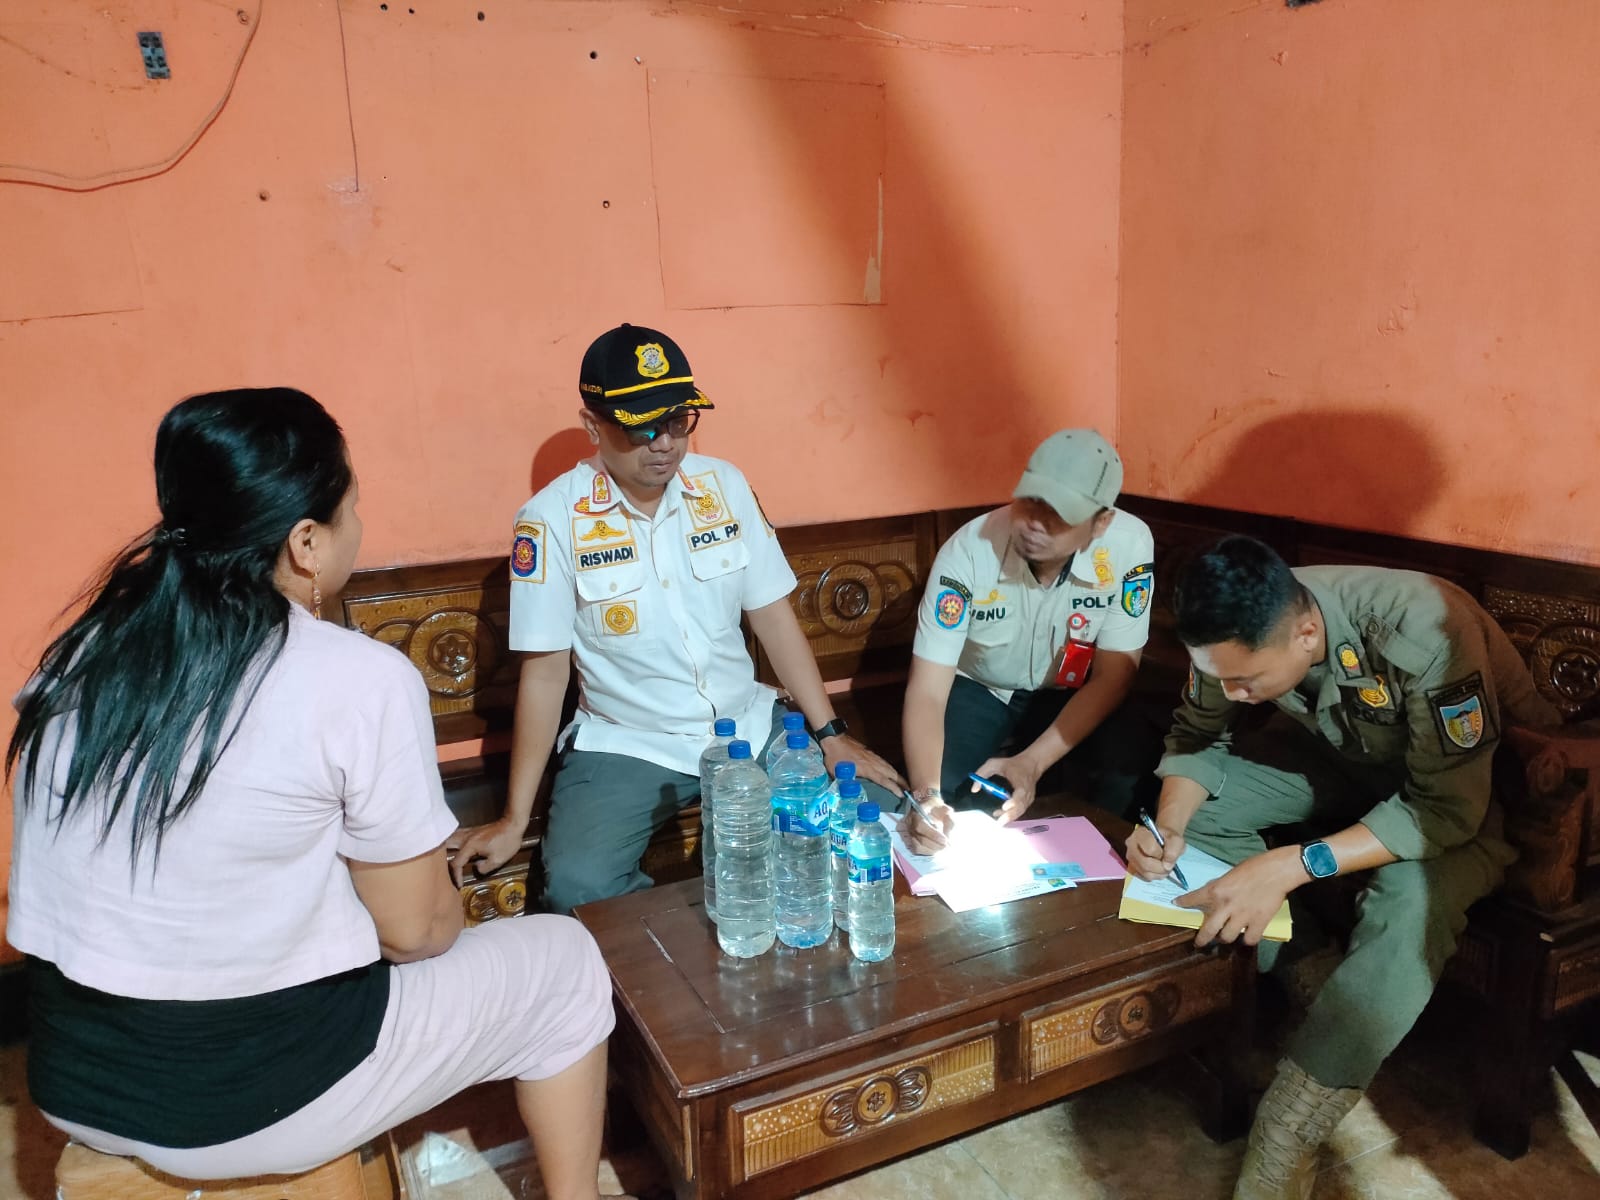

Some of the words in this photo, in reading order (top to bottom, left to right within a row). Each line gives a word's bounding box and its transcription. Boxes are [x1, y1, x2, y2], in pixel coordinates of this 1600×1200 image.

[690, 530, 720, 548] POL
[724, 523, 739, 538] PP
[580, 546, 634, 568] RISWADI
[1072, 596, 1106, 609] POL
